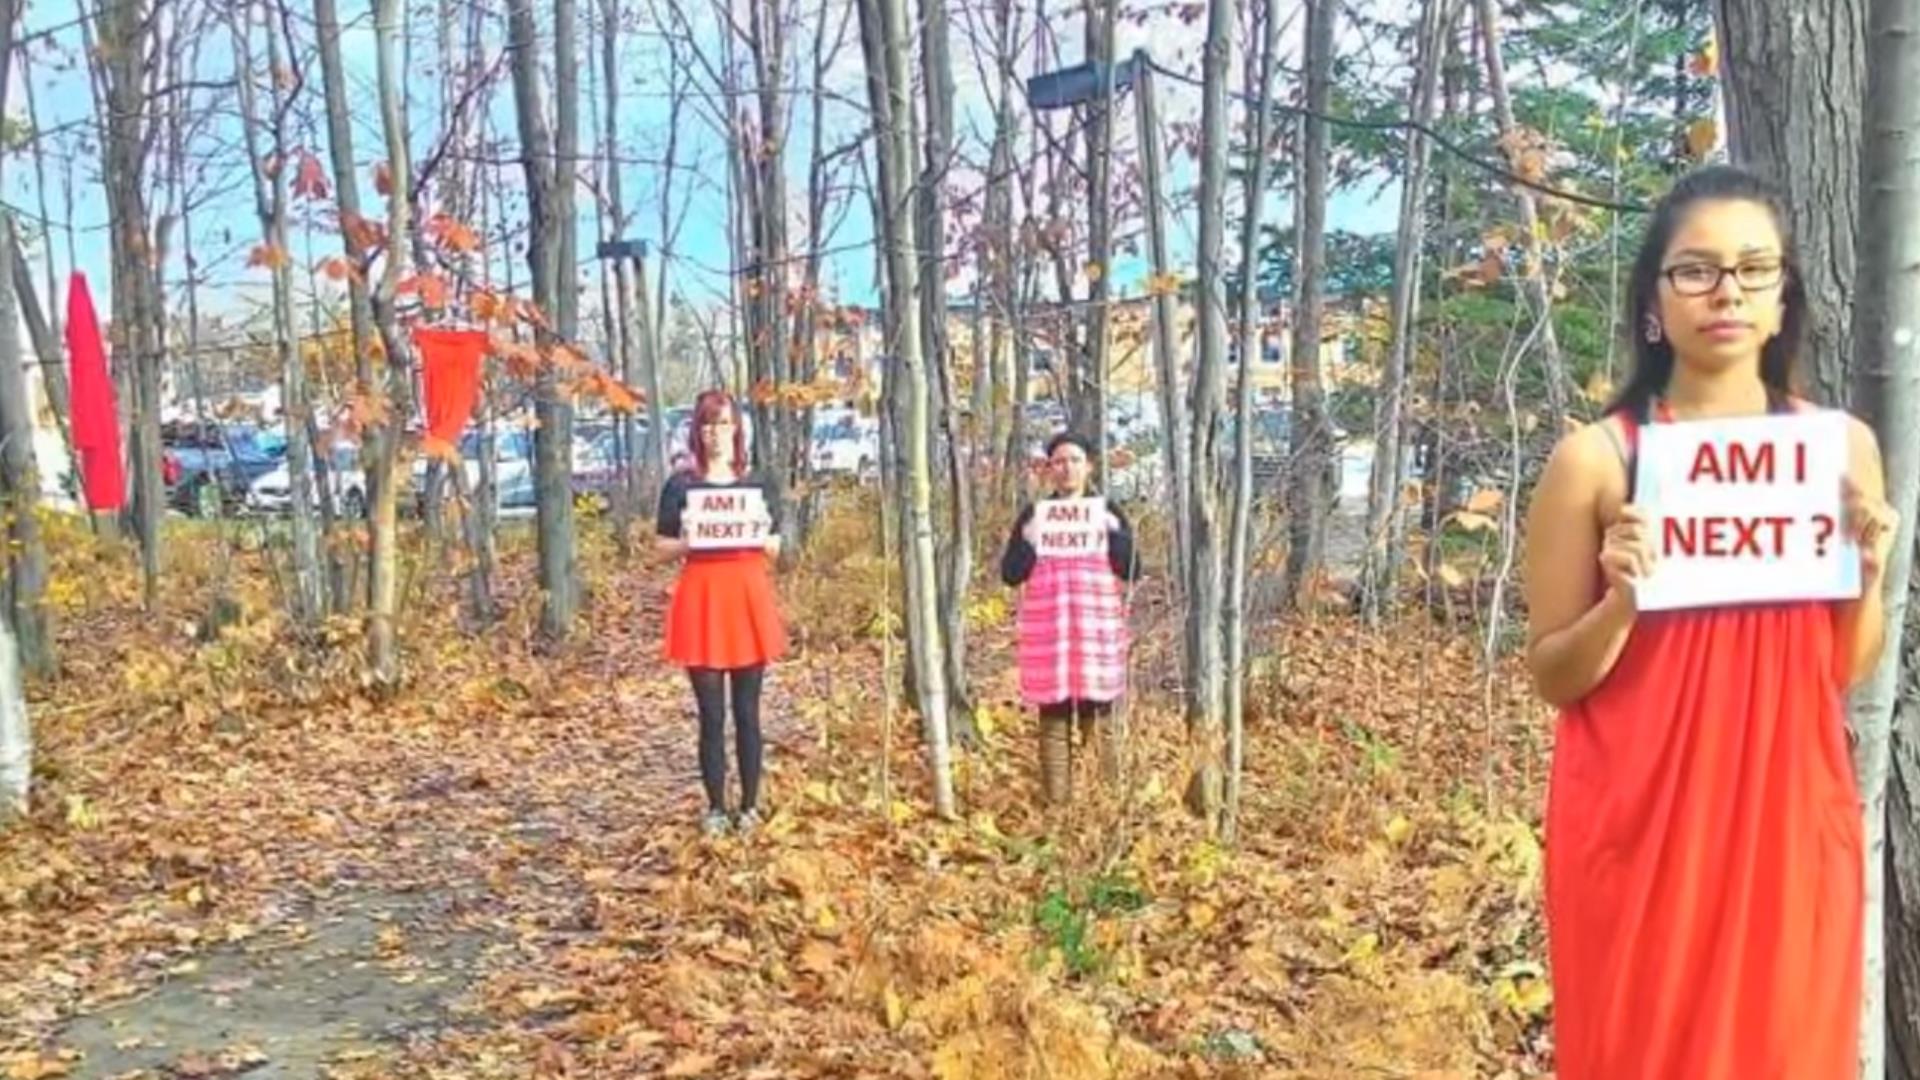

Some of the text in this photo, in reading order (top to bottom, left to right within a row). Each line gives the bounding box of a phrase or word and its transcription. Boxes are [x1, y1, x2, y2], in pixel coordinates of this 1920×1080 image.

[1688, 442, 1806, 483] AM I
[703, 494, 746, 511] AM I
[1046, 505, 1090, 522] AM I
[697, 521, 760, 538] NEXT ?
[1662, 514, 1835, 557] NEXT ?
[1041, 531, 1090, 548] NEXT
